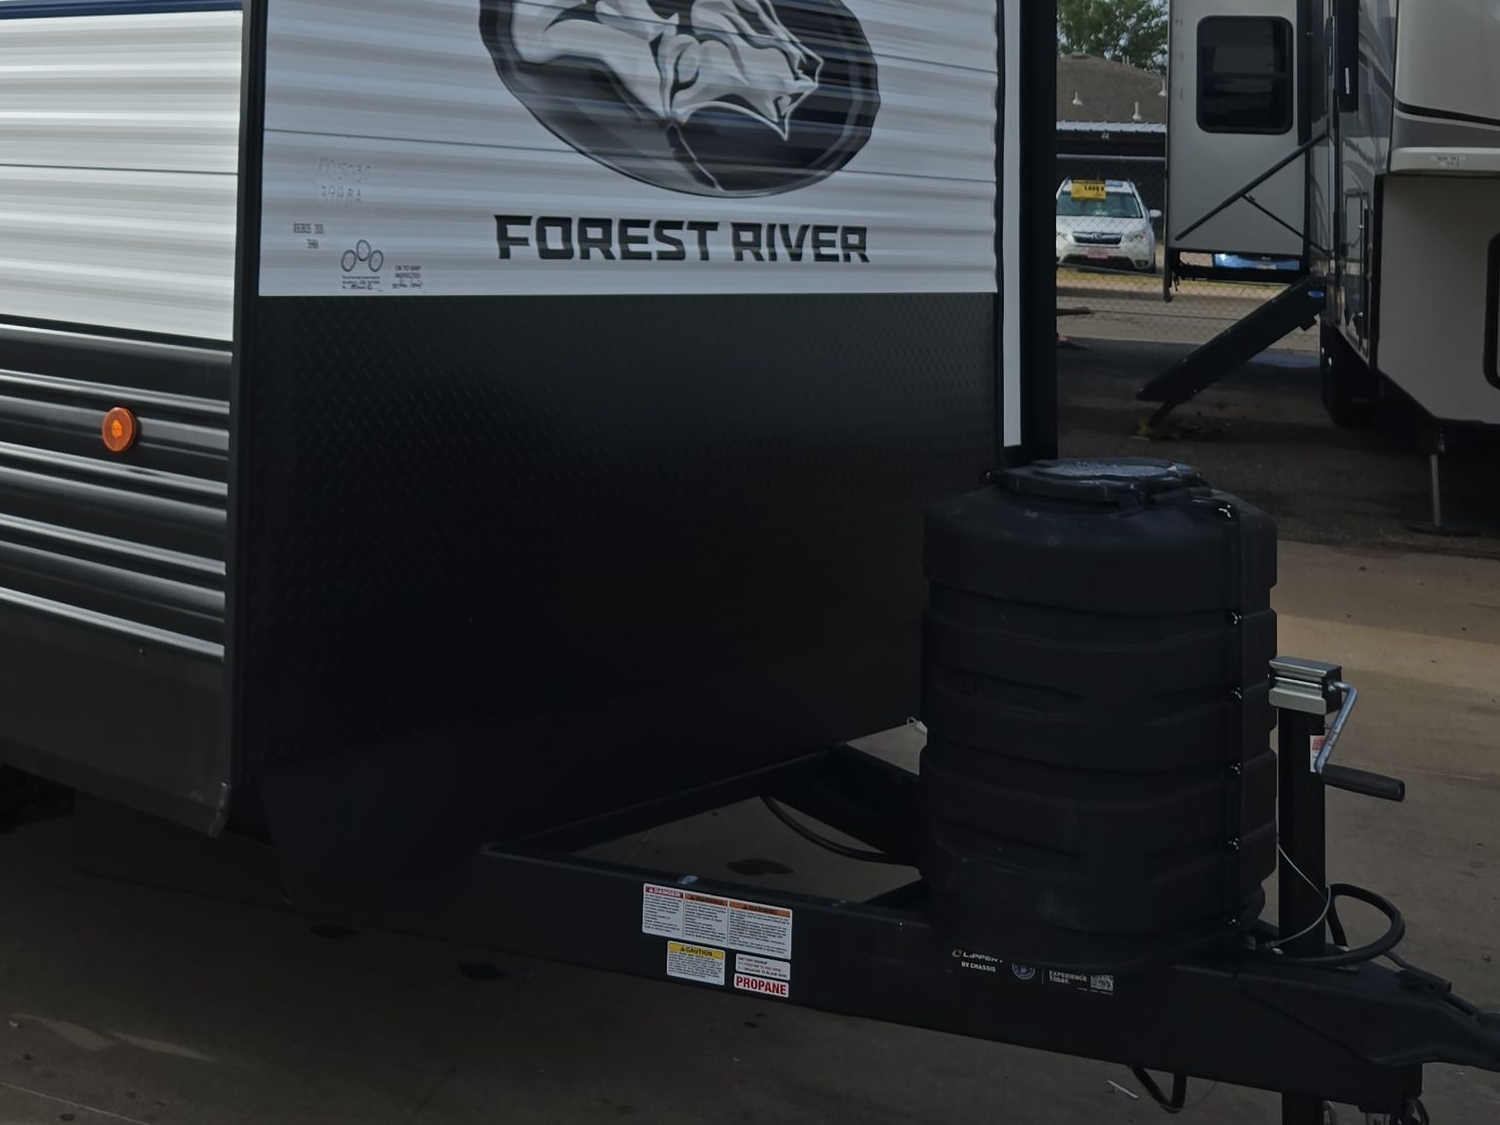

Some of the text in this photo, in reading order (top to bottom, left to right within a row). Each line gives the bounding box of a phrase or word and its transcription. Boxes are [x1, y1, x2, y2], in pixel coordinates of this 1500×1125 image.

[493, 214, 871, 264] FOREST RIVER
[736, 975, 787, 996] PROPANE
